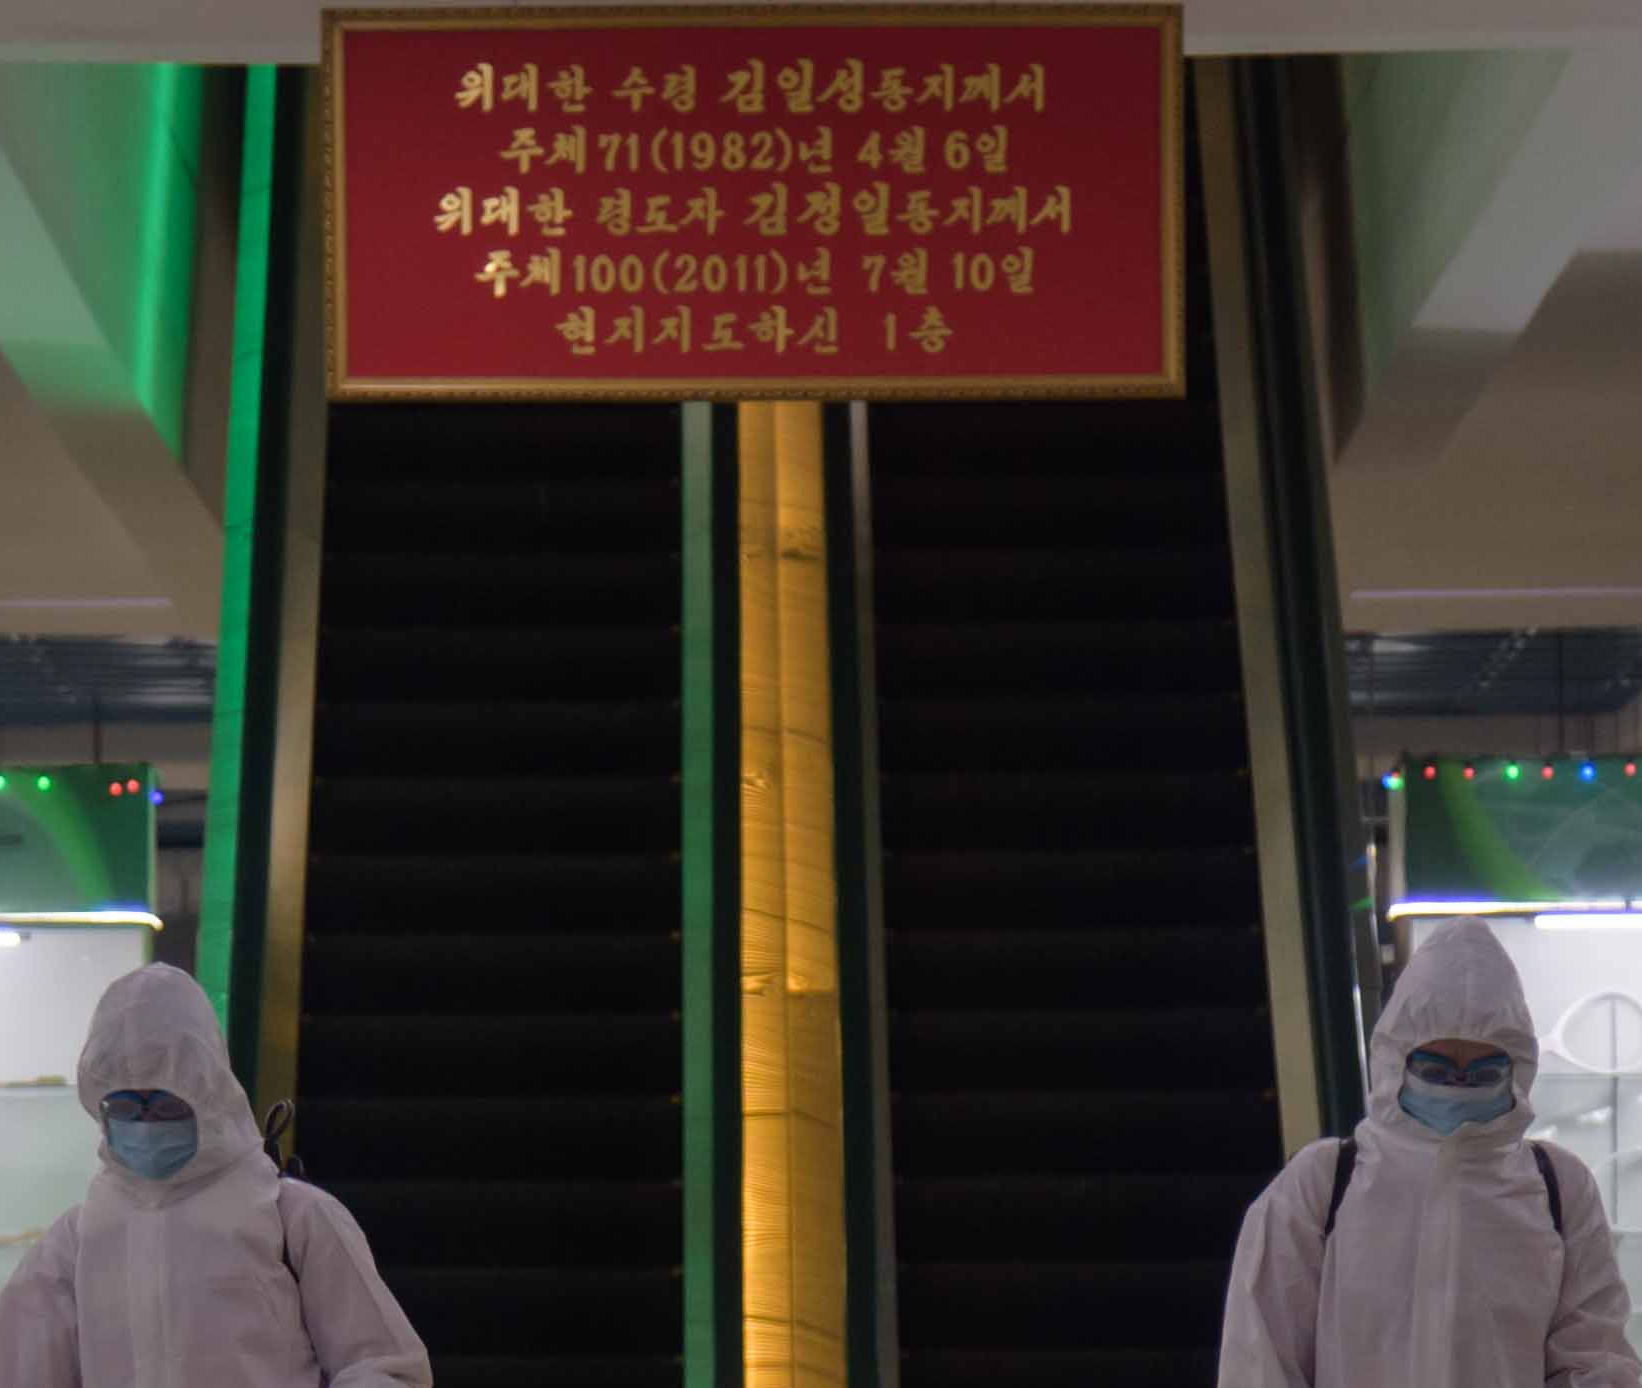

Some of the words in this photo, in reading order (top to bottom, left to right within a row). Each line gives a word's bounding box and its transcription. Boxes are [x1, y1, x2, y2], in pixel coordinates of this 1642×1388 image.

[455, 63, 593, 113] 위대한
[612, 64, 697, 114] 수령
[721, 57, 1045, 114] 김일성동지께서
[856, 125, 926, 174] 4월
[943, 125, 1008, 174] 6일
[433, 186, 573, 237] 위대한
[597, 187, 725, 236] 령도자
[743, 181, 1071, 236] 김정일동지께서
[862, 247, 928, 295] 7월
[954, 246, 1034, 294] 10일
[555, 304, 839, 355] 현지지도하신
